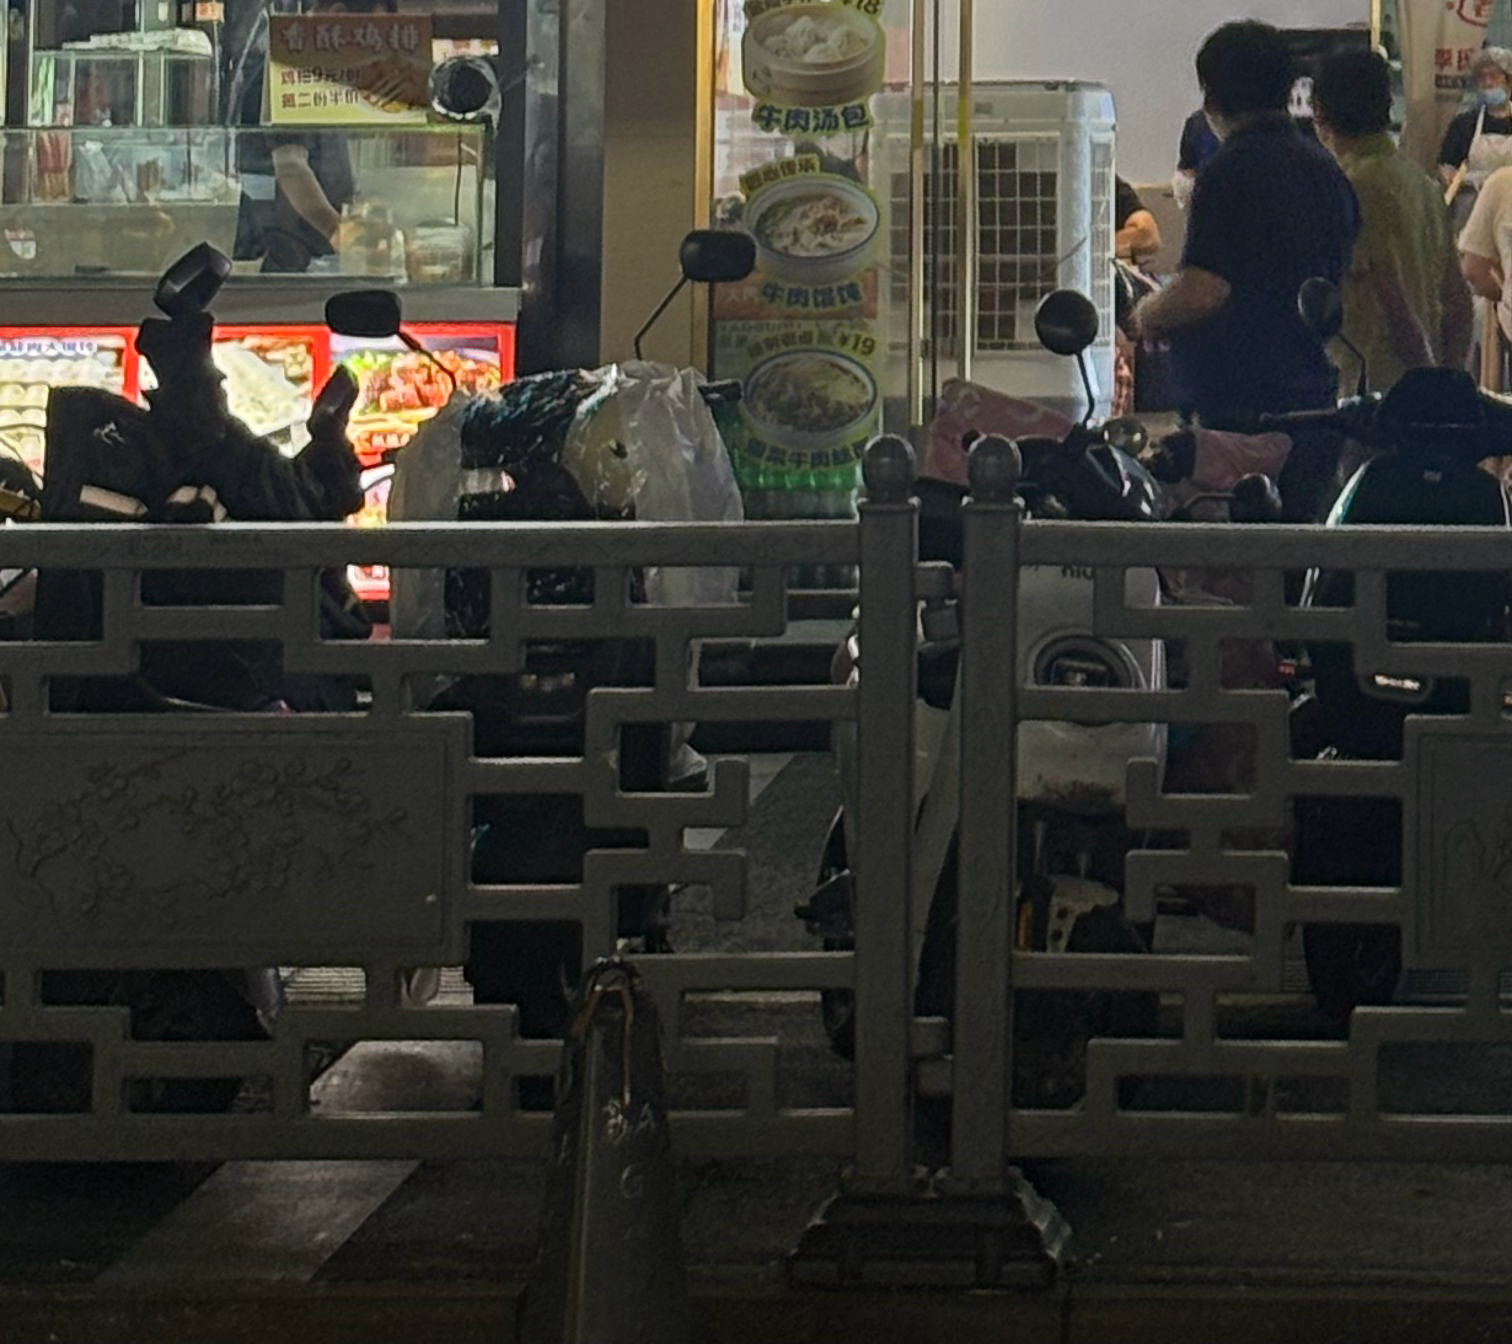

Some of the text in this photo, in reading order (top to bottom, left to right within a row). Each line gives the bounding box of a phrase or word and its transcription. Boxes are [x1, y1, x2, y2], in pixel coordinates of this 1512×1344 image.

[281, 23, 422, 52] 香酥鸡排
[756, 103, 869, 132] 牛肉汤包
[763, 282, 862, 308] 牛肉馄饨
